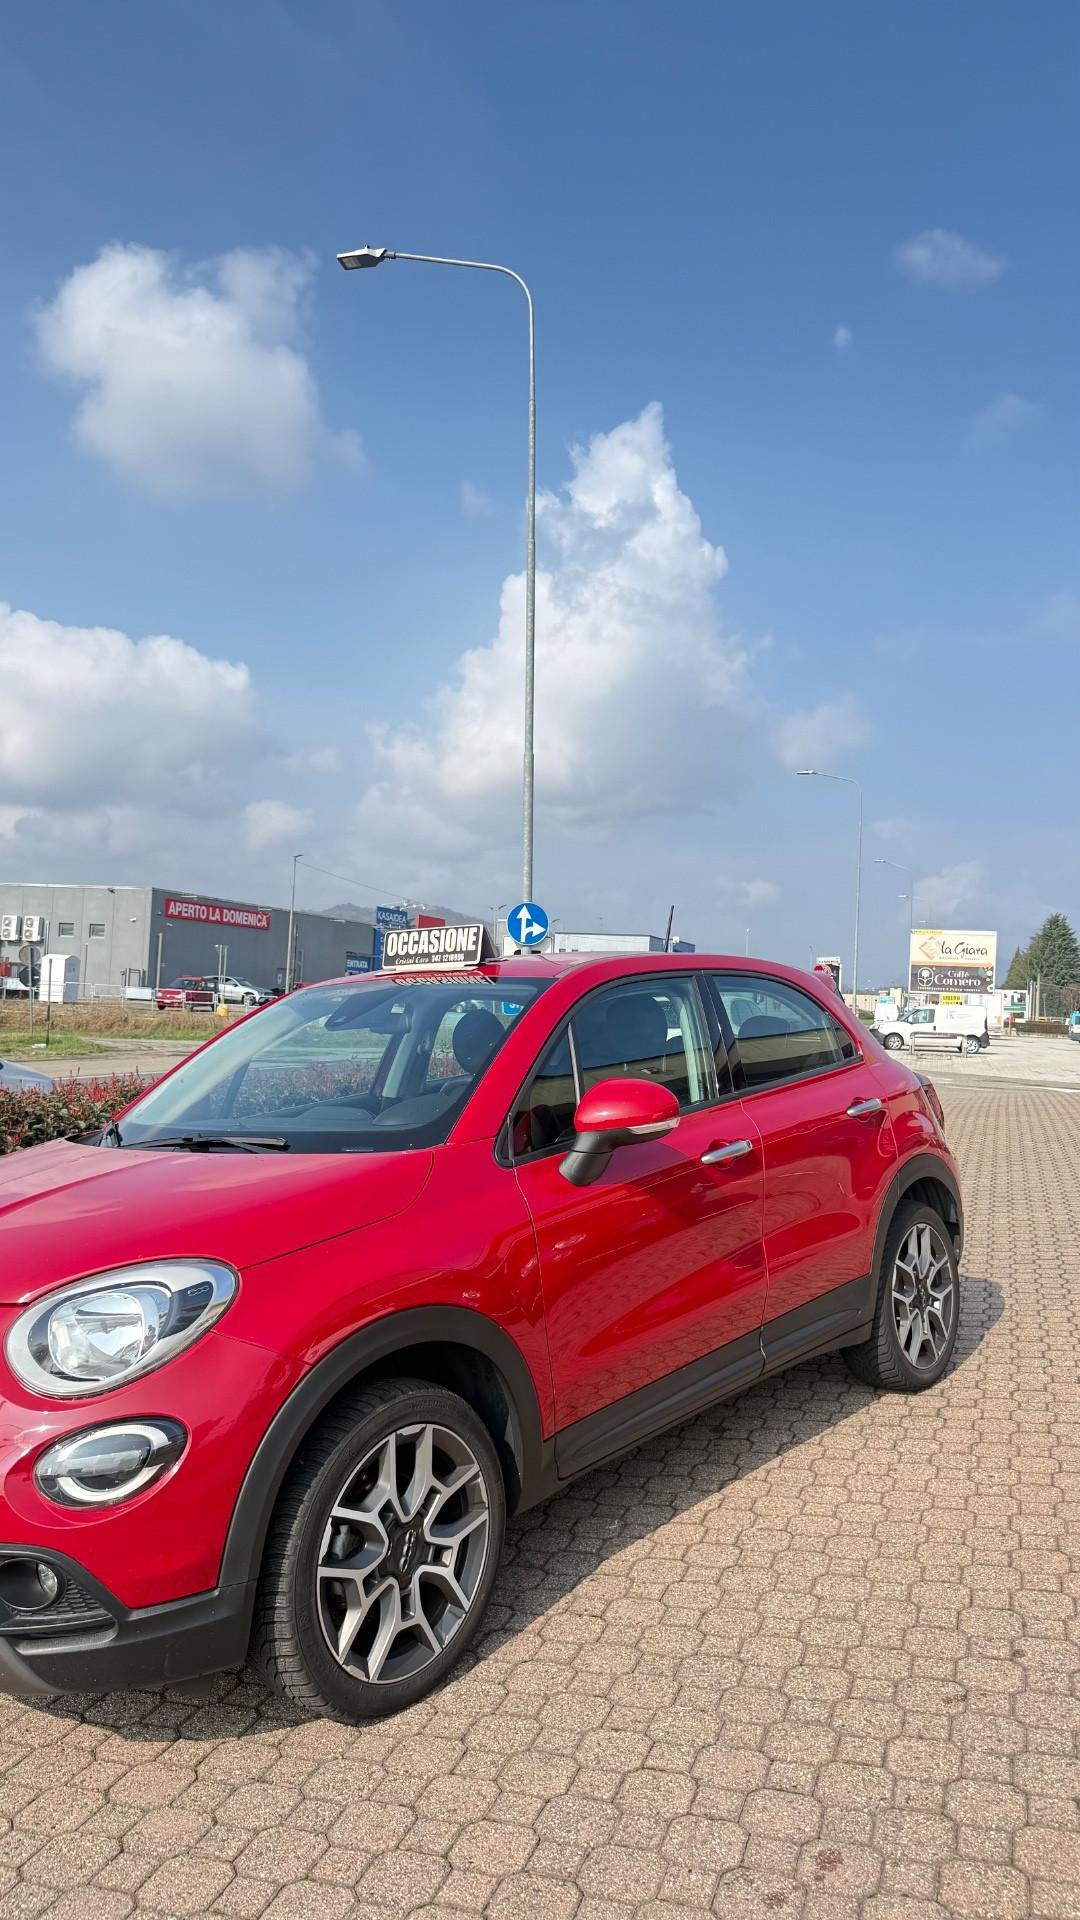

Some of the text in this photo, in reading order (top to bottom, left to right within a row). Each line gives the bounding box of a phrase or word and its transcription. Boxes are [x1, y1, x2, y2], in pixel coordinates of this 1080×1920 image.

[168, 901, 267, 927] APERTO LA DOMENICA
[387, 927, 477, 956] OCCASIONE
[954, 941, 988, 958] Giara
[346, 959, 368, 969] ENTRATA
